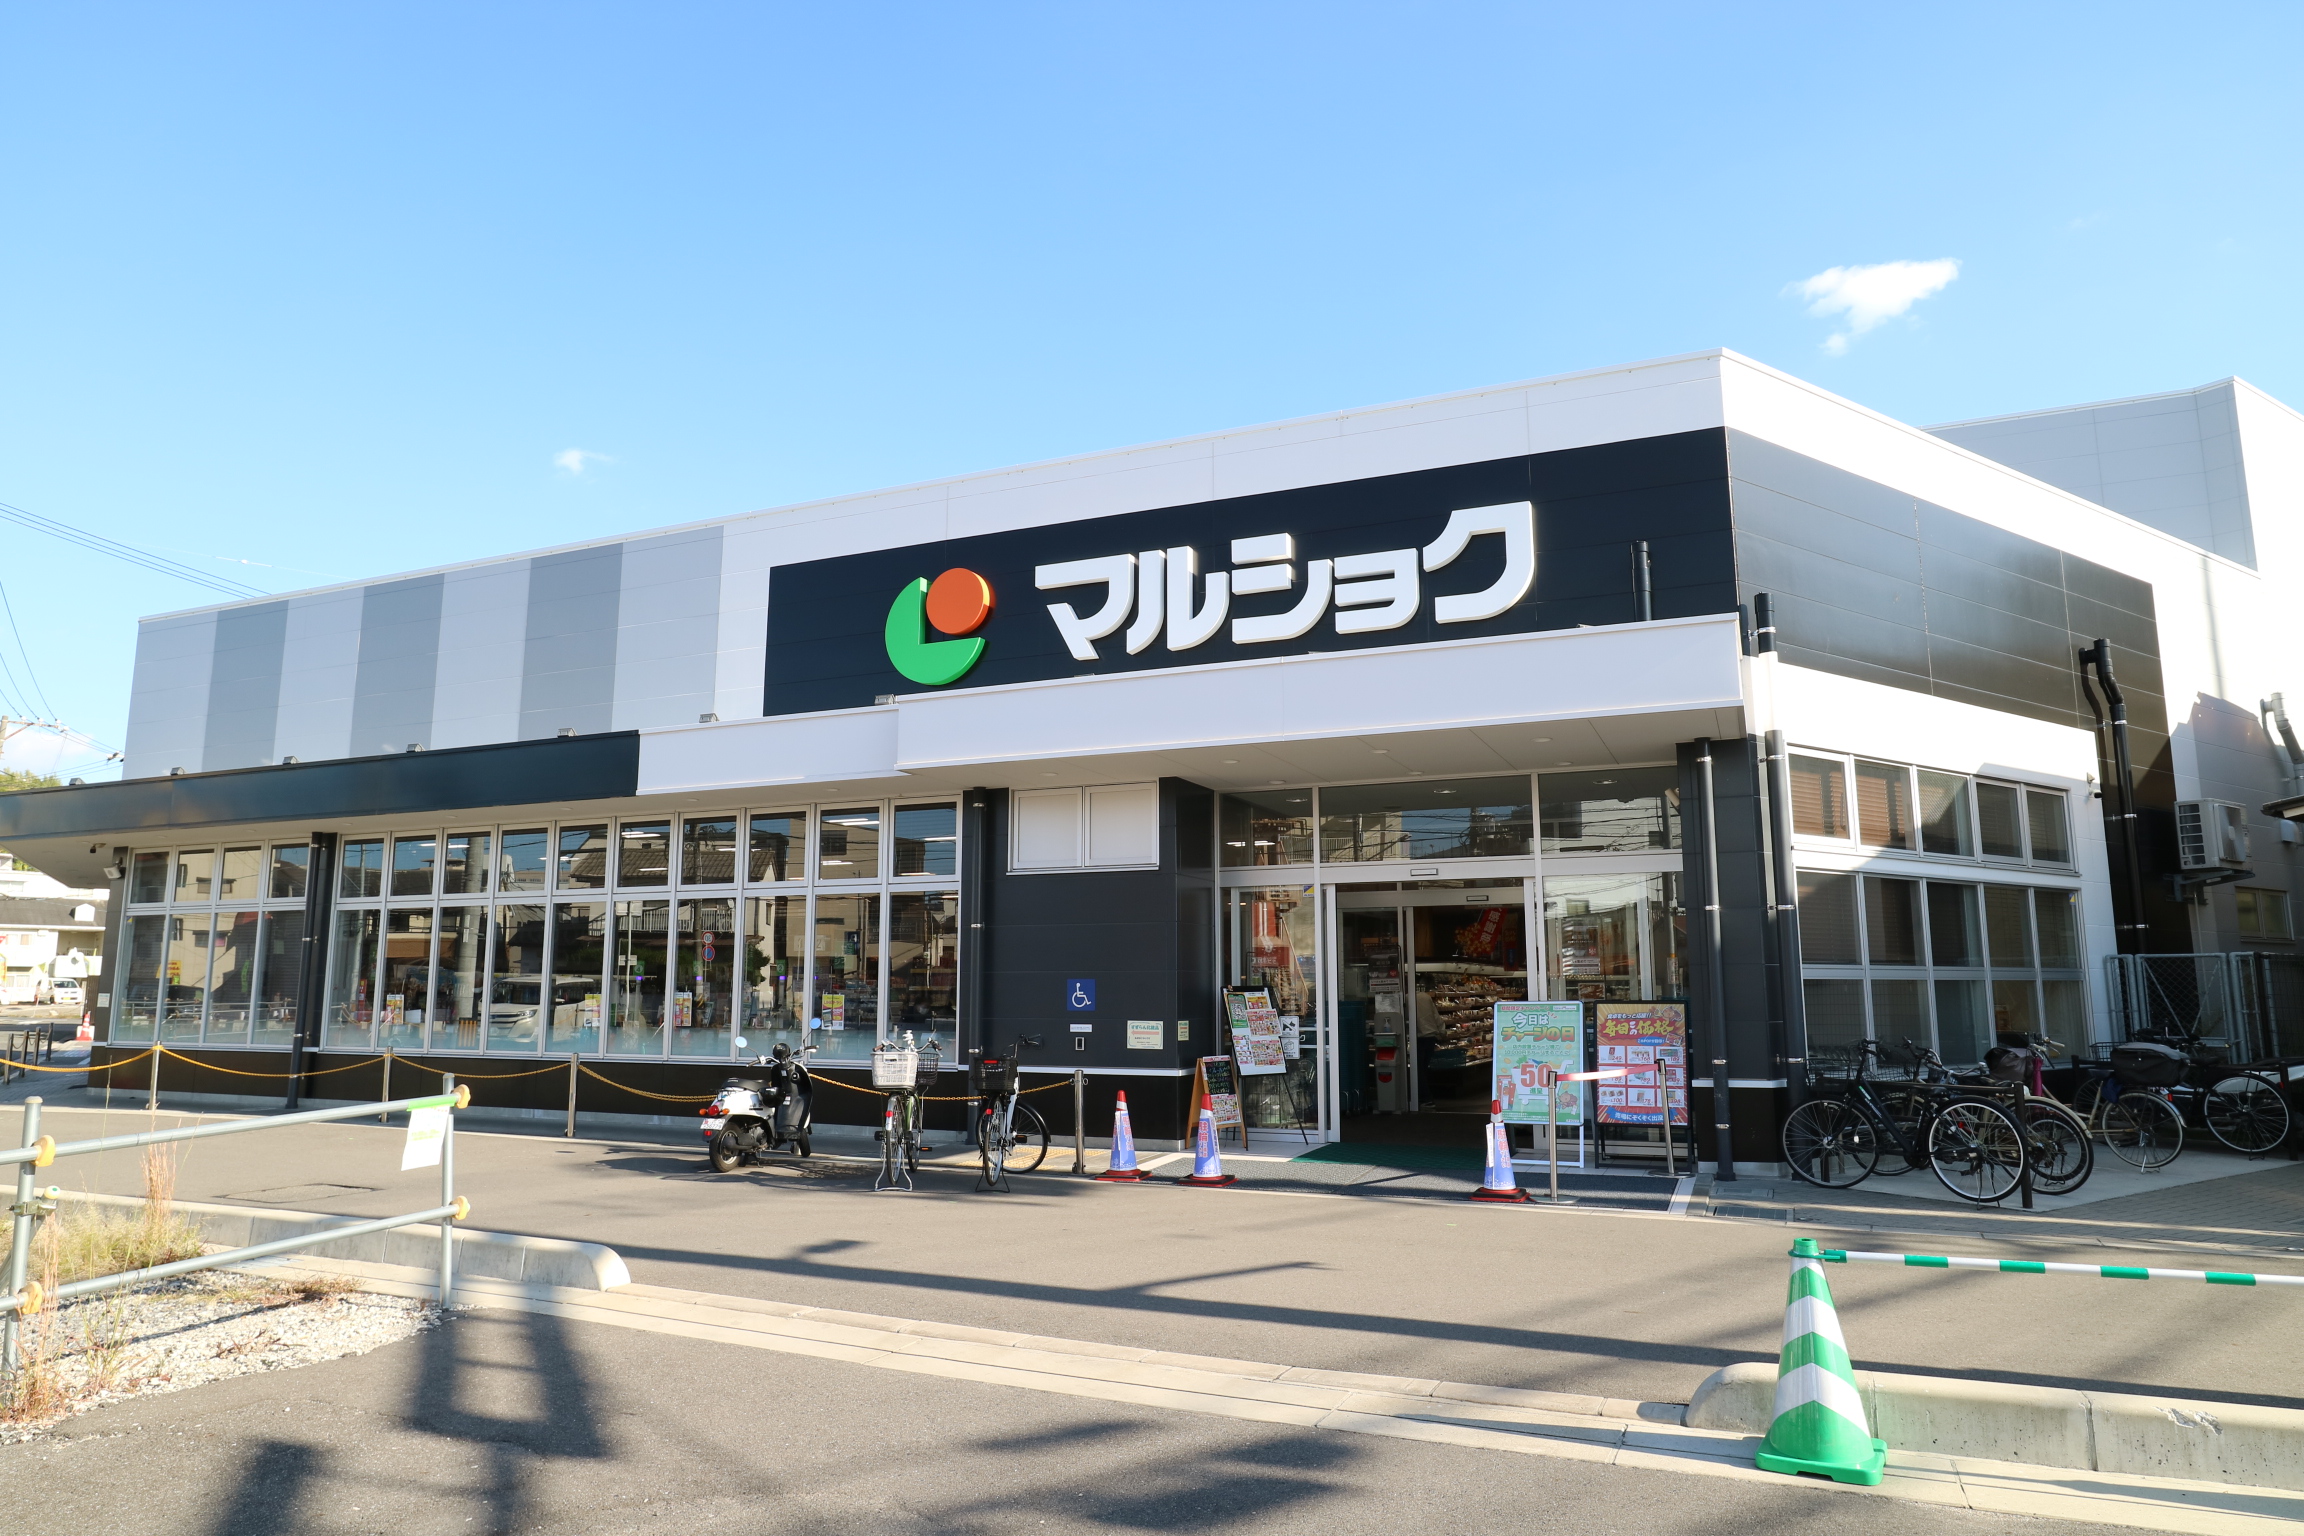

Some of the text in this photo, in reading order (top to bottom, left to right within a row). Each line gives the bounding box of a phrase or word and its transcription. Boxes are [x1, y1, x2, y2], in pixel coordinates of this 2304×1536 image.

[1034, 499, 1537, 661] マルショク
[1511, 1012, 1549, 1028] 今日は
[1501, 1026, 1575, 1042] チャージの日
[1520, 1063, 1551, 1088] 50
